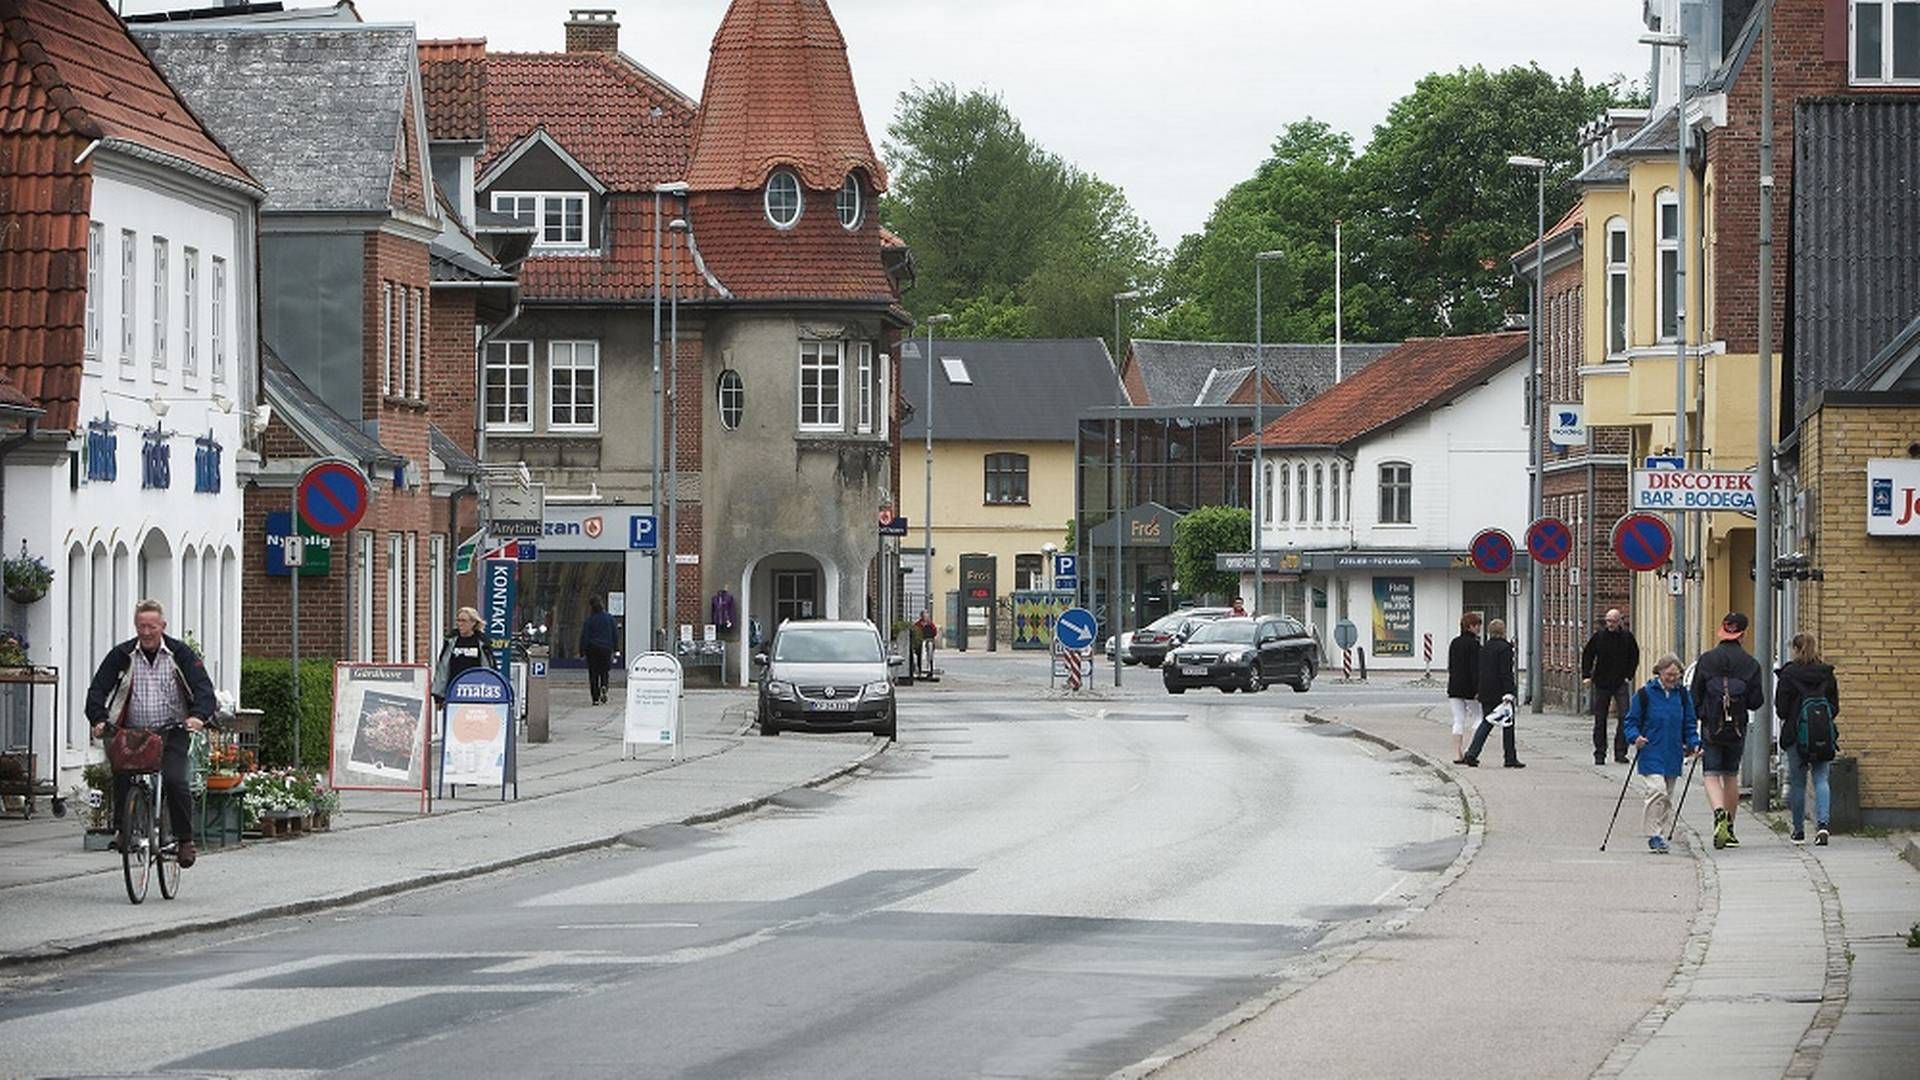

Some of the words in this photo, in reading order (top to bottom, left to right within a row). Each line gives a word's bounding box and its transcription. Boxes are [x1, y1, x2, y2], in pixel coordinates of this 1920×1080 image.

[1648, 473, 1753, 490] DISCOTEK
[1641, 491, 1674, 505] BAR
[1685, 492, 1756, 507] BODEGA
[1896, 488, 1920, 525] J
[492, 523, 541, 538] Anytime
[636, 519, 652, 541] P
[1060, 557, 1073, 574] P
[490, 565, 508, 636] KONTAKT
[534, 662, 544, 675] P
[456, 683, 501, 699] matas
